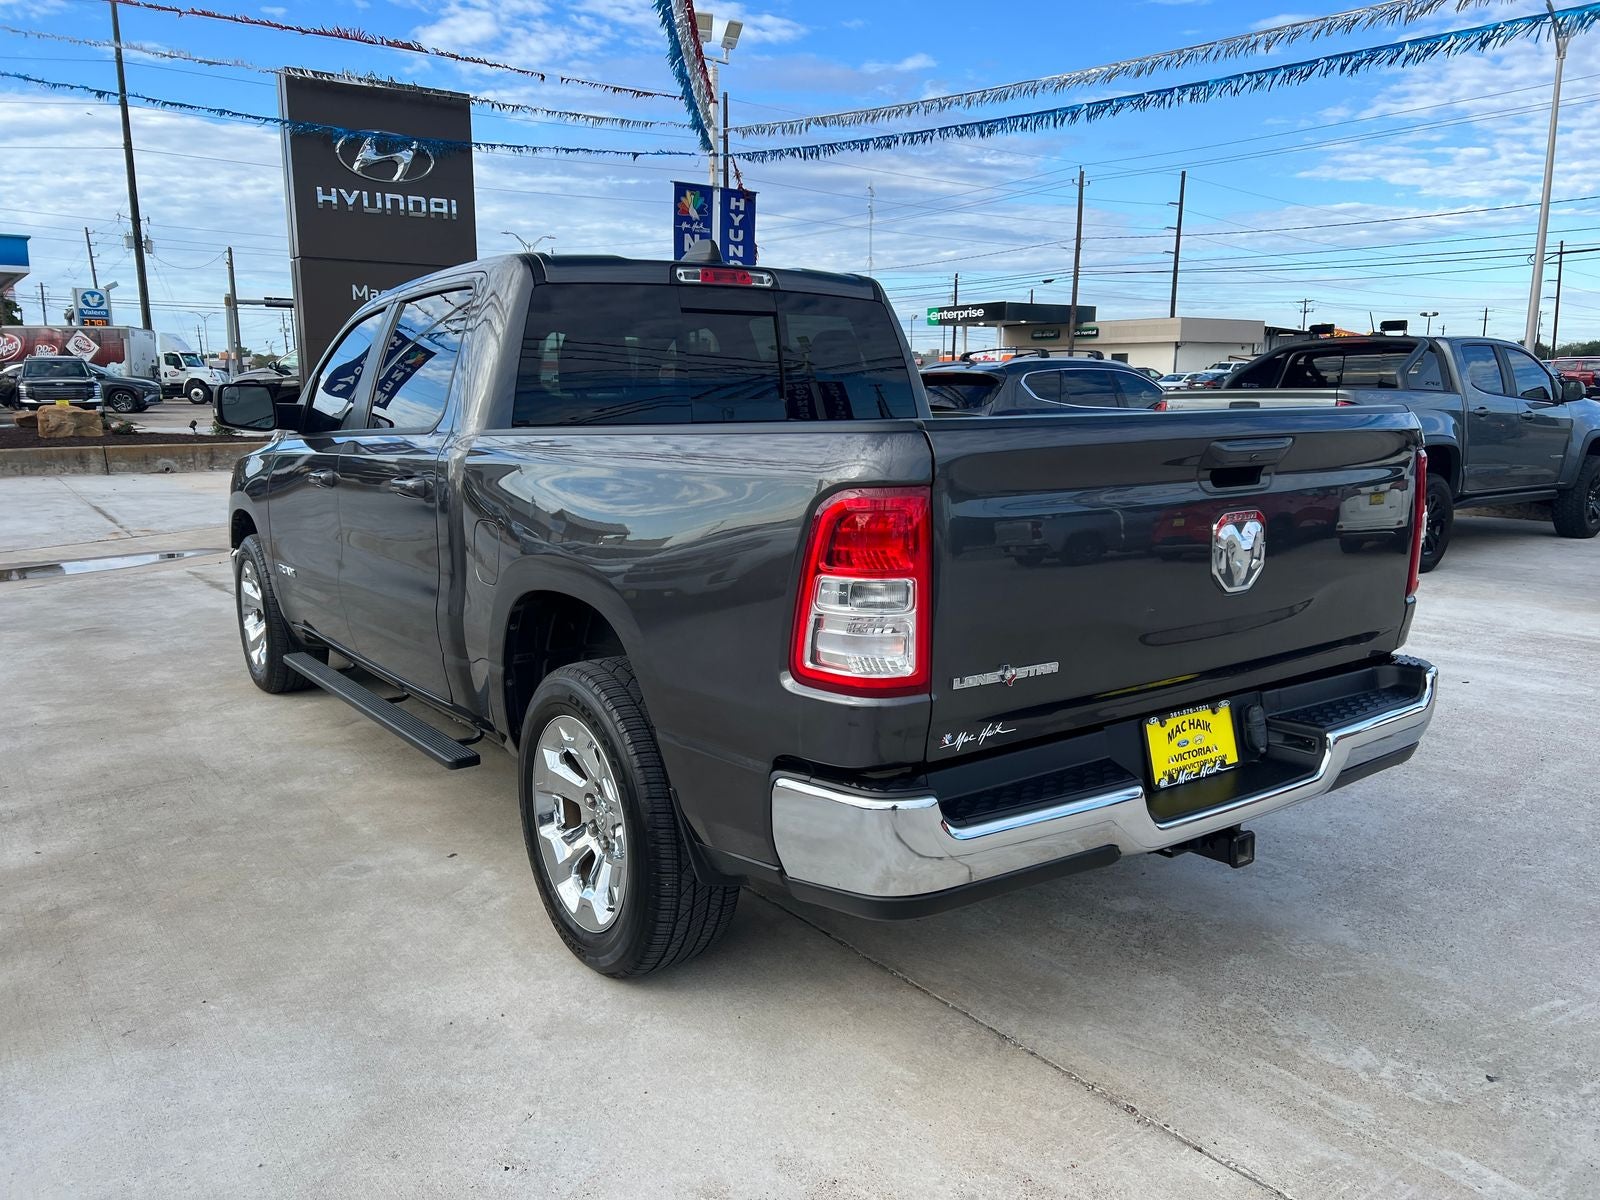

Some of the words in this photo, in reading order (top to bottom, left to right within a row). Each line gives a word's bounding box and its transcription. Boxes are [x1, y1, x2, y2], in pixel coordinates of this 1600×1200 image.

[316, 186, 457, 220] HYUNDAI
[728, 197, 745, 265] HYUN
[927, 307, 985, 321] enterprise
[952, 670, 1002, 690] LONE
[1016, 661, 1060, 679] STAR
[1167, 720, 1187, 744] MAC
[1188, 718, 1212, 733] HAIK
[1173, 745, 1212, 763] VICTORIA
[1176, 769, 1199, 784] Mac
[1199, 759, 1235, 777] Haik
